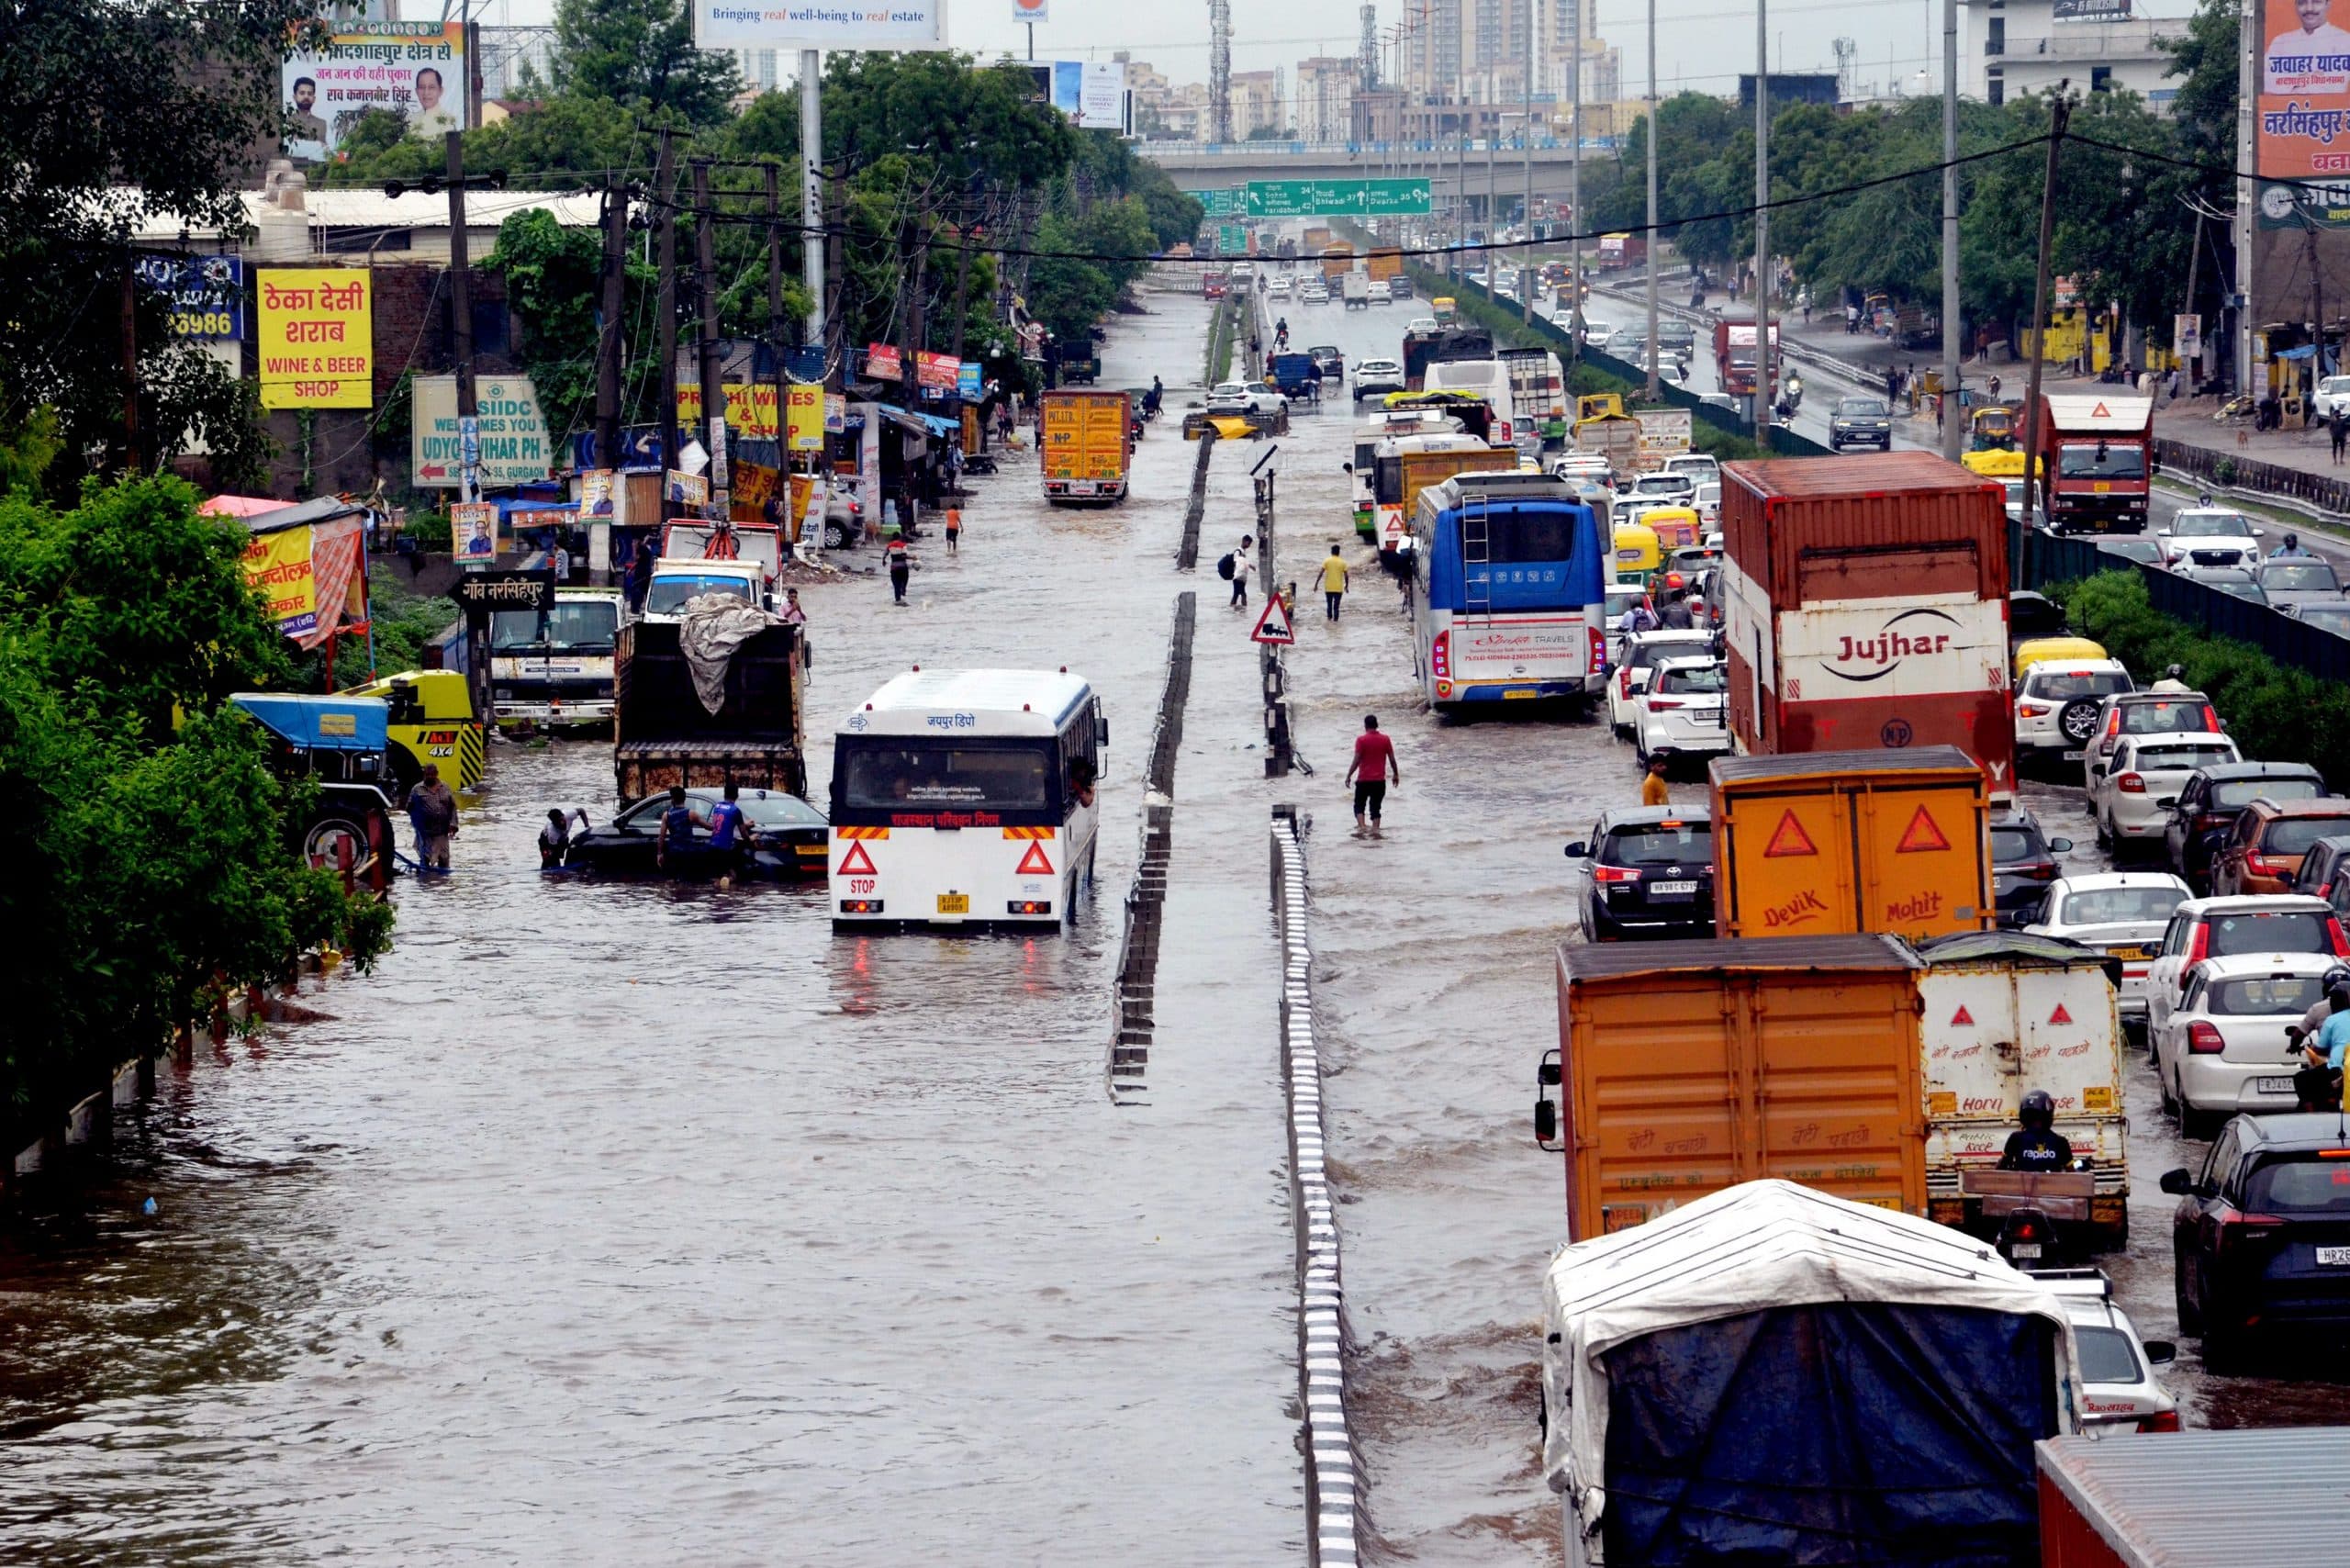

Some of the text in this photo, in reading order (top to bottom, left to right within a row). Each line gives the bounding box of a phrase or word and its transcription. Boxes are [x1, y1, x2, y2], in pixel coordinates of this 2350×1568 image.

[713, 7, 924, 23] Bringing real well-being to real estate
[407, 40, 432, 61] क्षेत्र
[438, 39, 452, 61] से
[2269, 55, 2313, 73] जवाहर
[316, 68, 331, 81] जन
[335, 69, 351, 81] जन
[353, 66, 366, 81] की
[387, 68, 411, 84] पुकार
[327, 89, 342, 102] राव
[392, 87, 412, 103] सिंह
[2264, 102, 2344, 144] नरसिंहपुर
[264, 280, 364, 311] ठेका देसी
[285, 320, 346, 343] शराब
[266, 357, 365, 373] WINE & BEER
[294, 381, 340, 398] SHOP
[754, 391, 815, 406] WIES
[740, 408, 753, 421] &
[509, 419, 537, 432] YOU
[521, 437, 541, 460] PH
[507, 466, 545, 478] GURGAON
[1090, 469, 1115, 477] HORN
[1535, 635, 1573, 644] TRAVELS
[1837, 632, 1950, 665] Jujhar
[927, 715, 953, 730] जयपुर
[851, 879, 875, 894] STOP
[1886, 890, 1943, 923] Mohit
[2022, 1148, 2056, 1159] rapido
